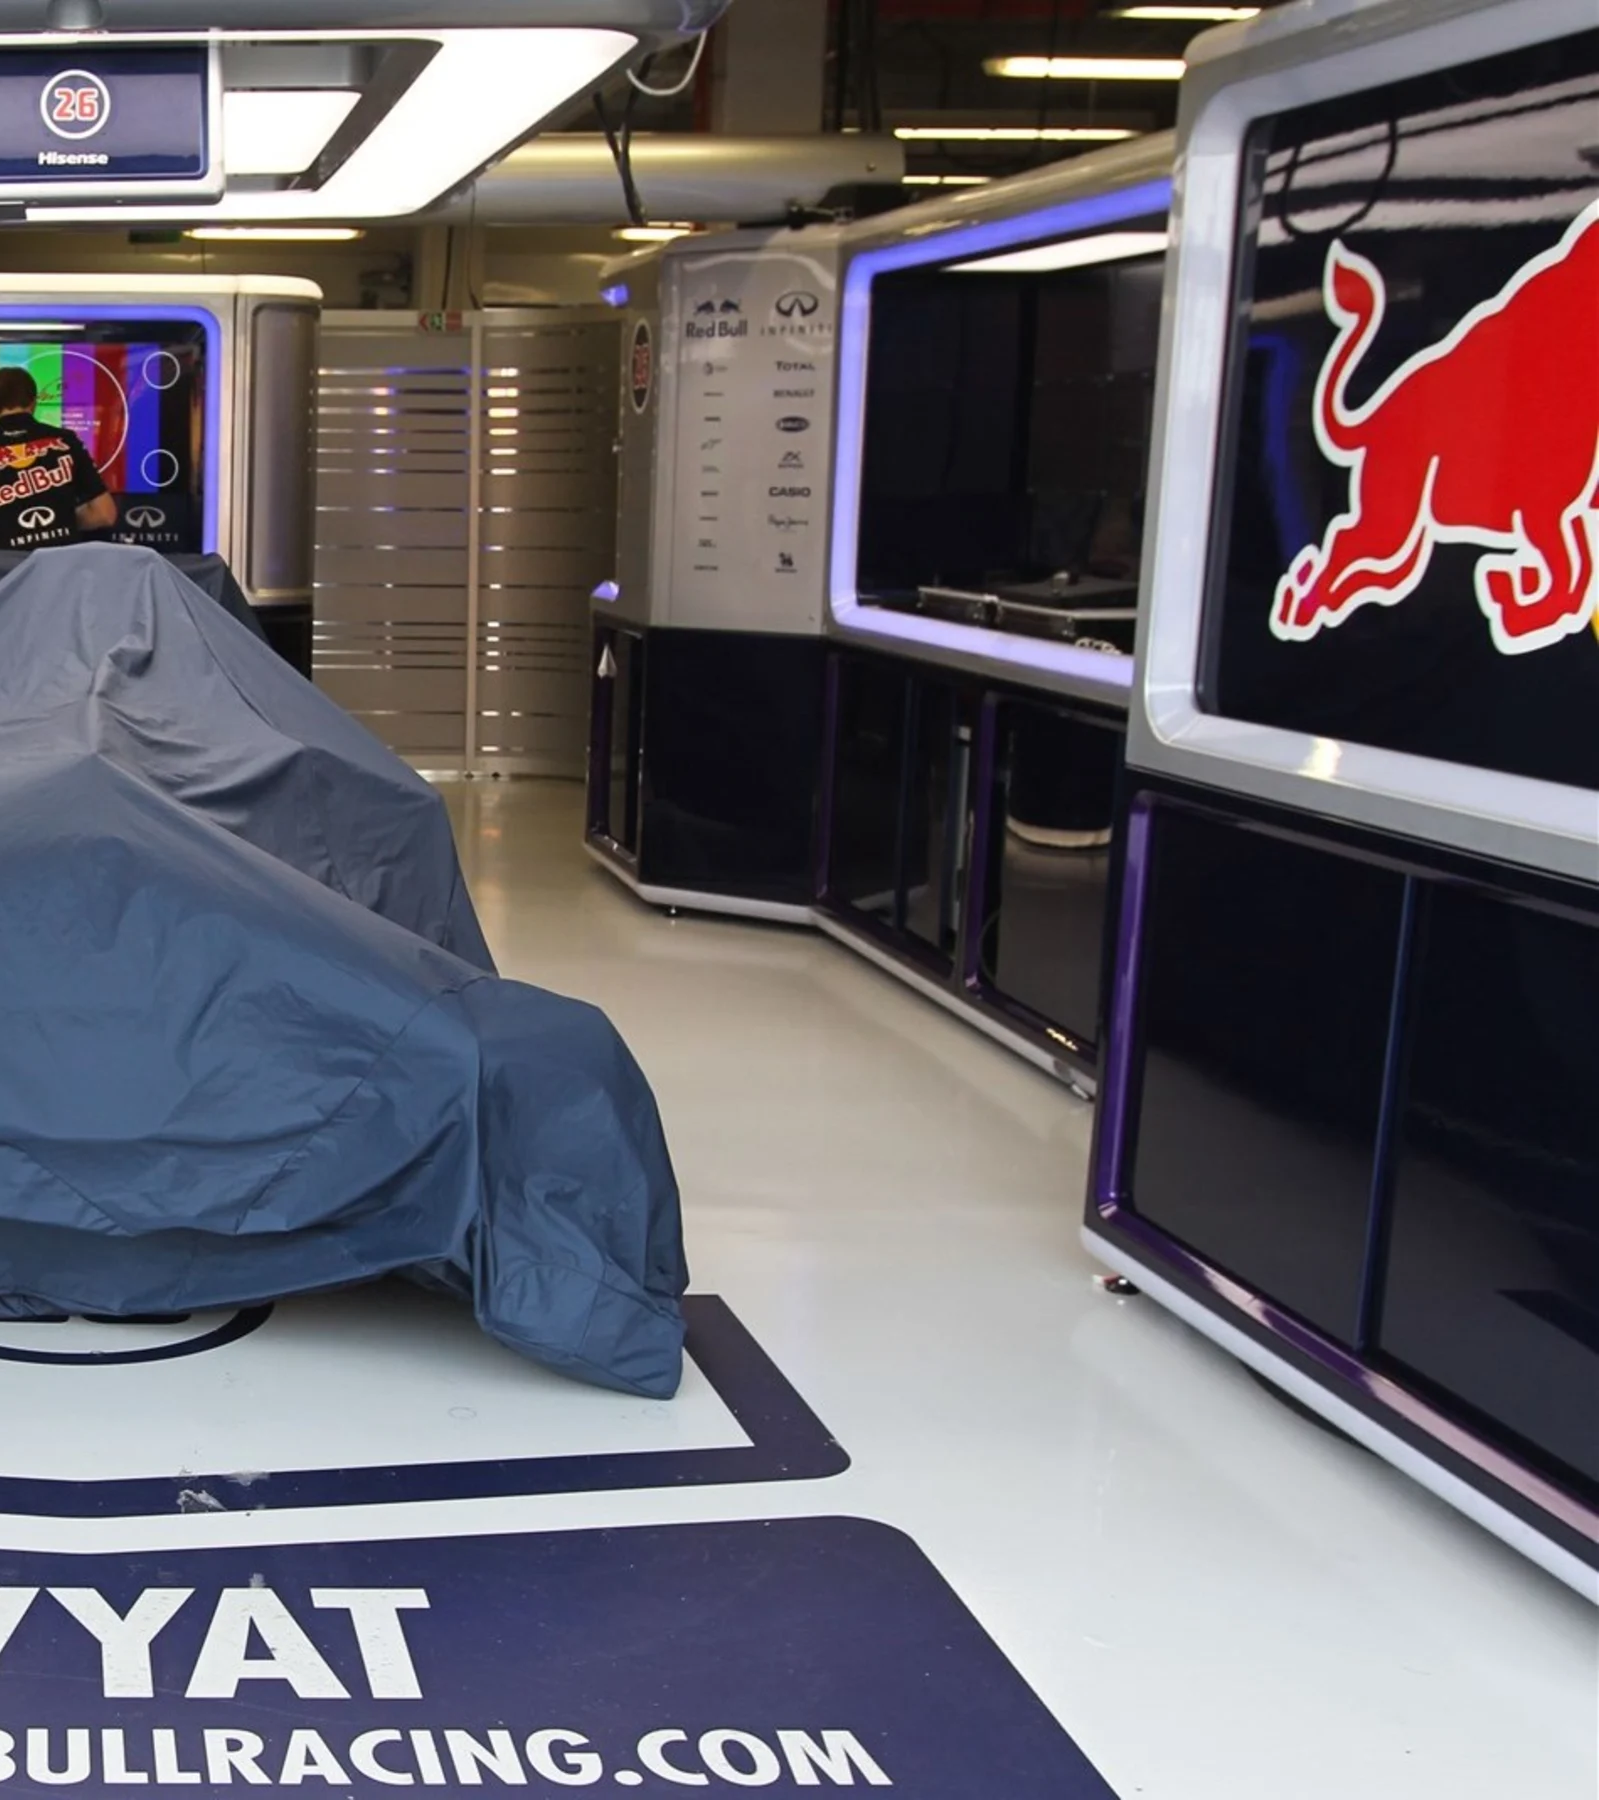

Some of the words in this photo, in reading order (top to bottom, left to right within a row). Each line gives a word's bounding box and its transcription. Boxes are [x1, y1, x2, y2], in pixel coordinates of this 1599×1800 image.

[53, 87, 99, 122] 26
[38, 151, 109, 166] Hisense
[759, 323, 833, 337] INFINITI
[768, 486, 811, 498] CASIO
[10, 527, 70, 547] INFINITI
